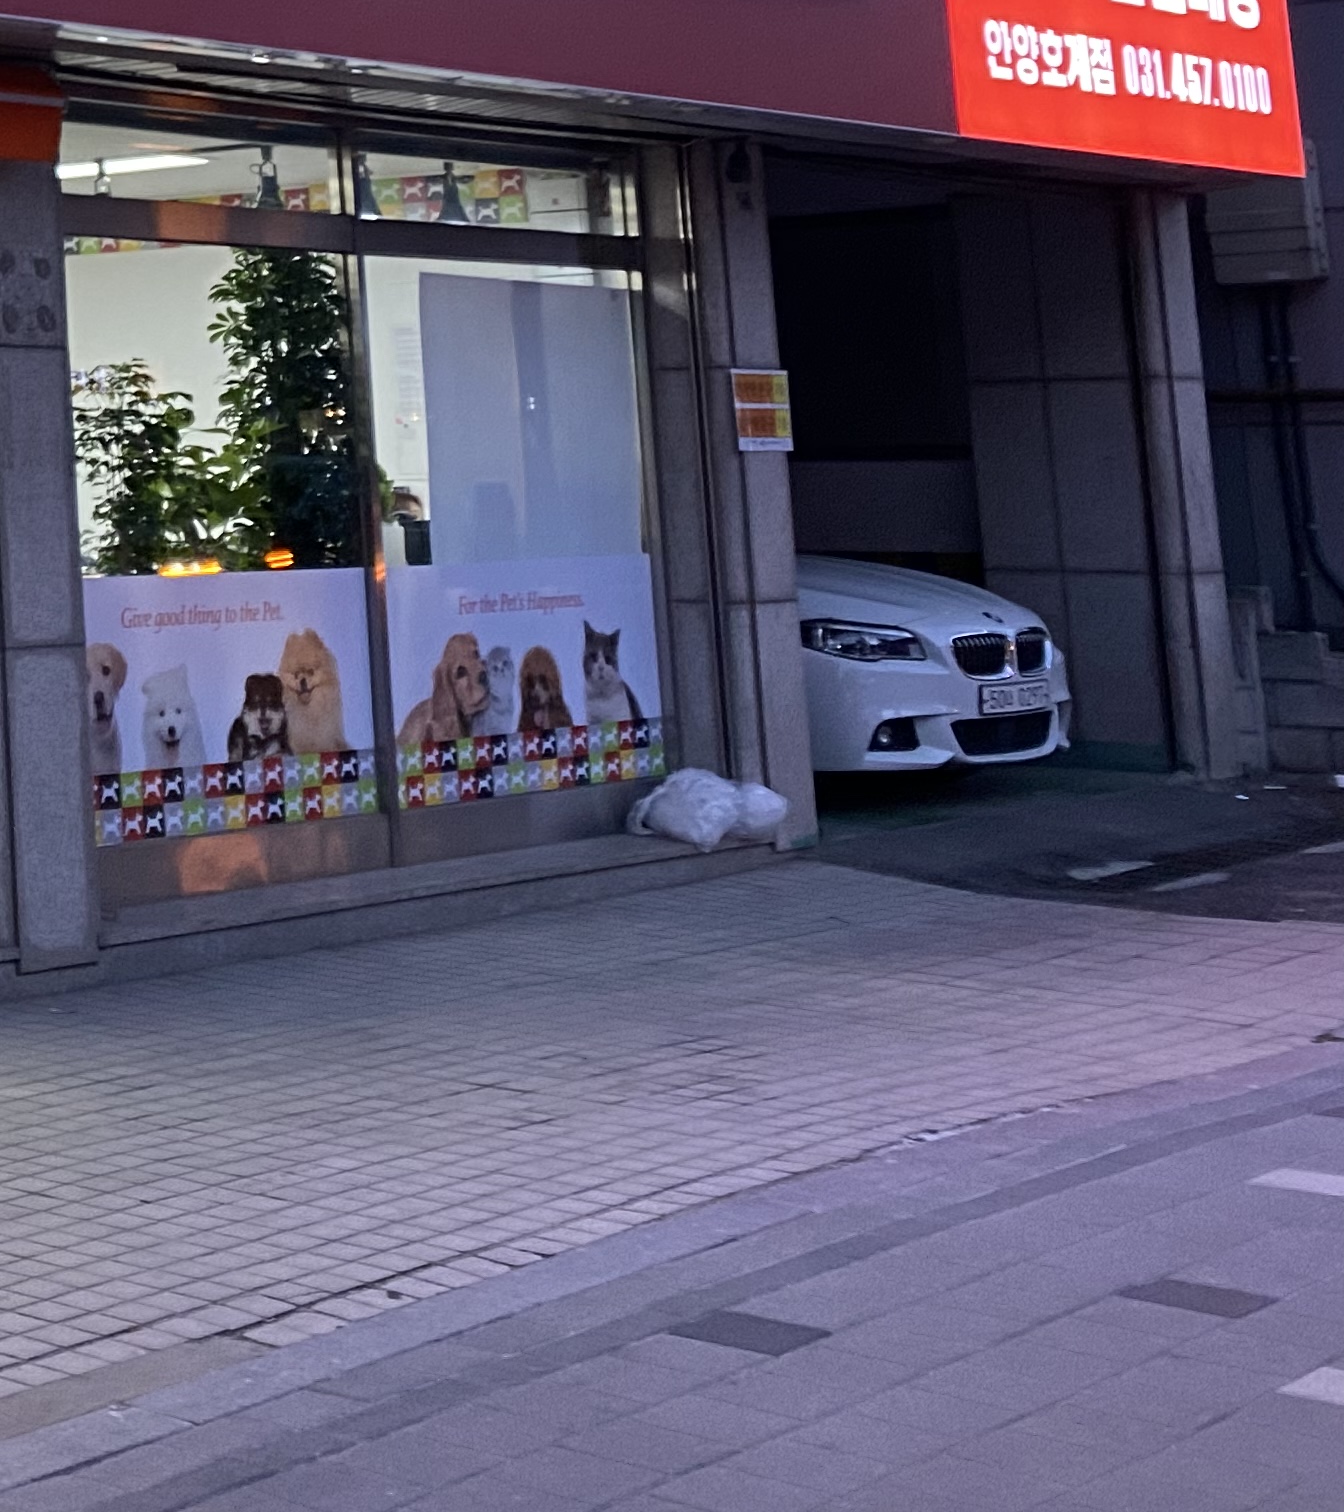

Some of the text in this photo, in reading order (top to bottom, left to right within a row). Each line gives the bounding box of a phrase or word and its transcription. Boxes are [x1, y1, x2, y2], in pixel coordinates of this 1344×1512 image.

[983, 18, 1272, 115] 안양호계점 031.457.0100
[224, 606, 238, 624] to
[240, 601, 260, 622] the
